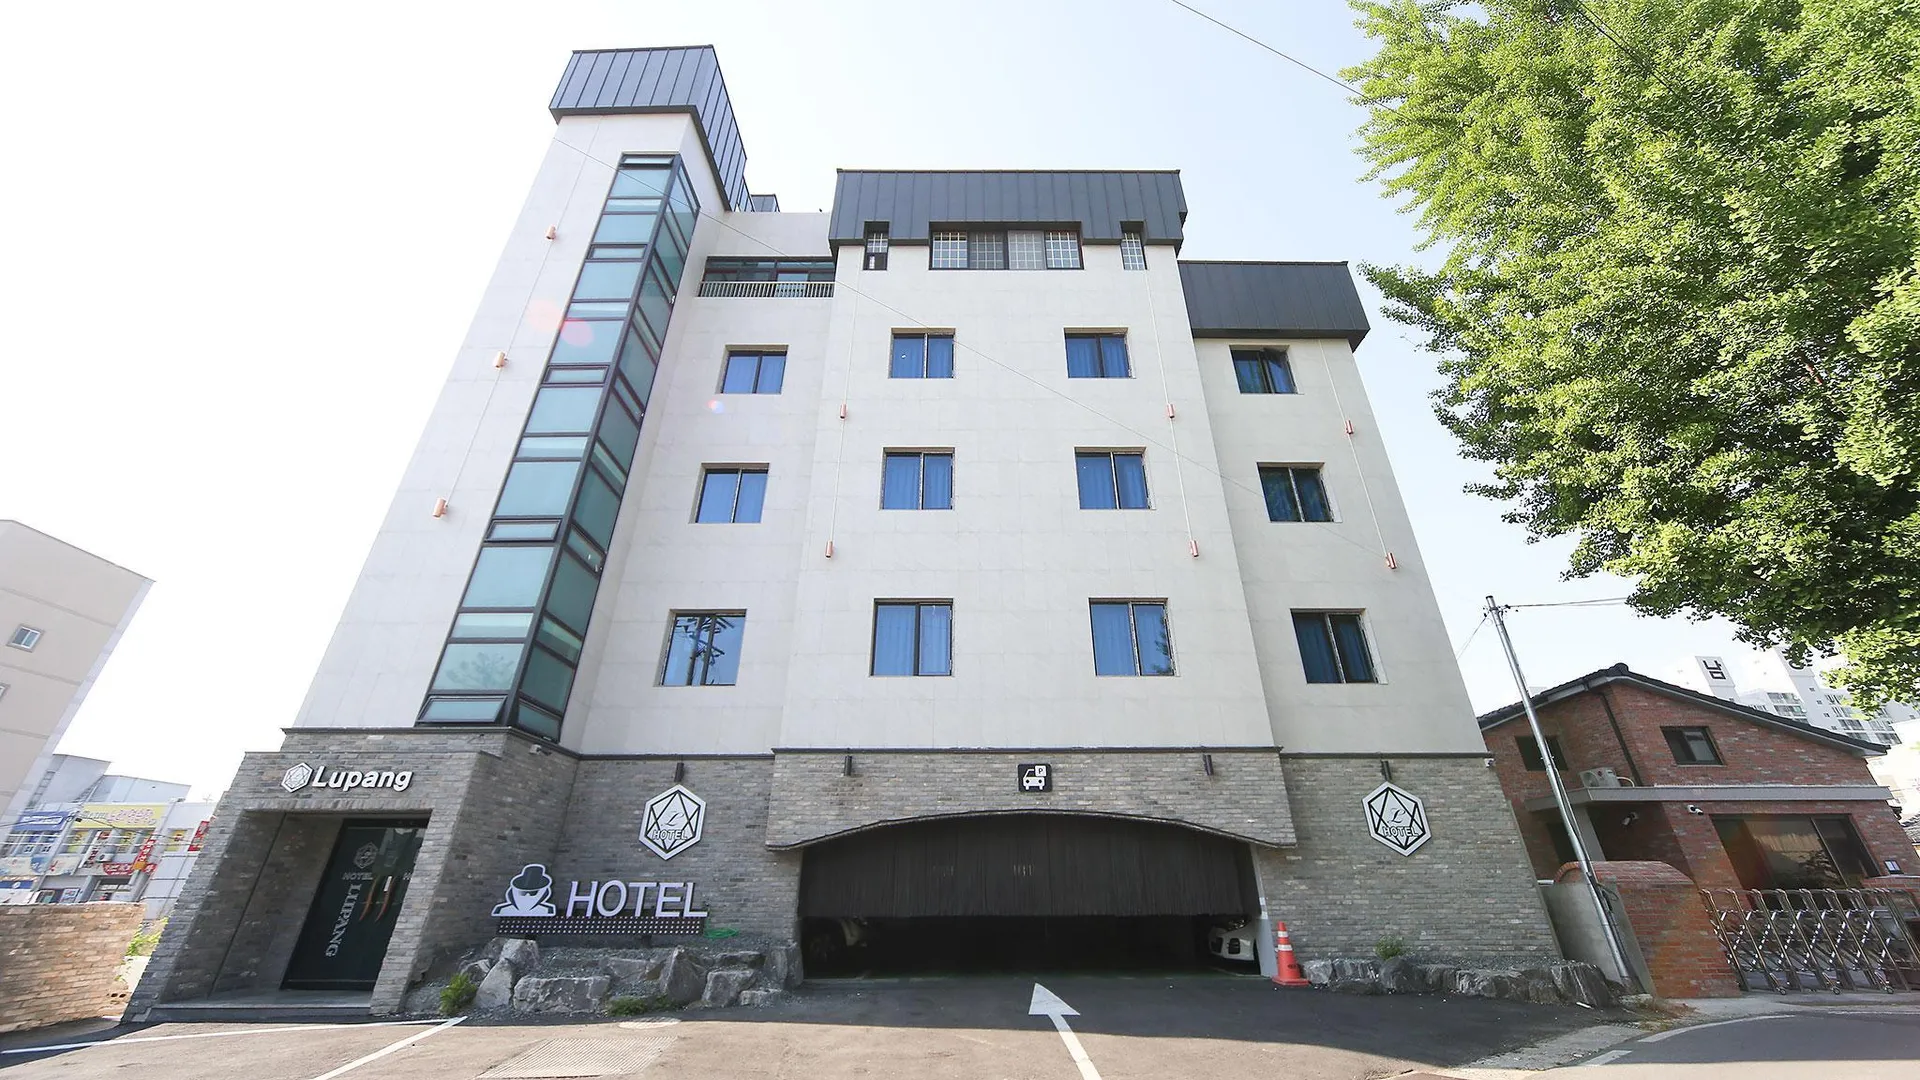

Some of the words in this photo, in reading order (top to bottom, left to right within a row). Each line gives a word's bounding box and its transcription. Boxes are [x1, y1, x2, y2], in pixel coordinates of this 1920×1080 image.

[1702, 659, 1727, 680] 남
[311, 765, 413, 792] Lupang
[652, 829, 689, 841] HOTEL
[1382, 826, 1418, 837] HOTEL
[342, 872, 373, 881] HOTEL
[566, 880, 708, 918] HOTEL
[325, 883, 362, 957] LUPANG
